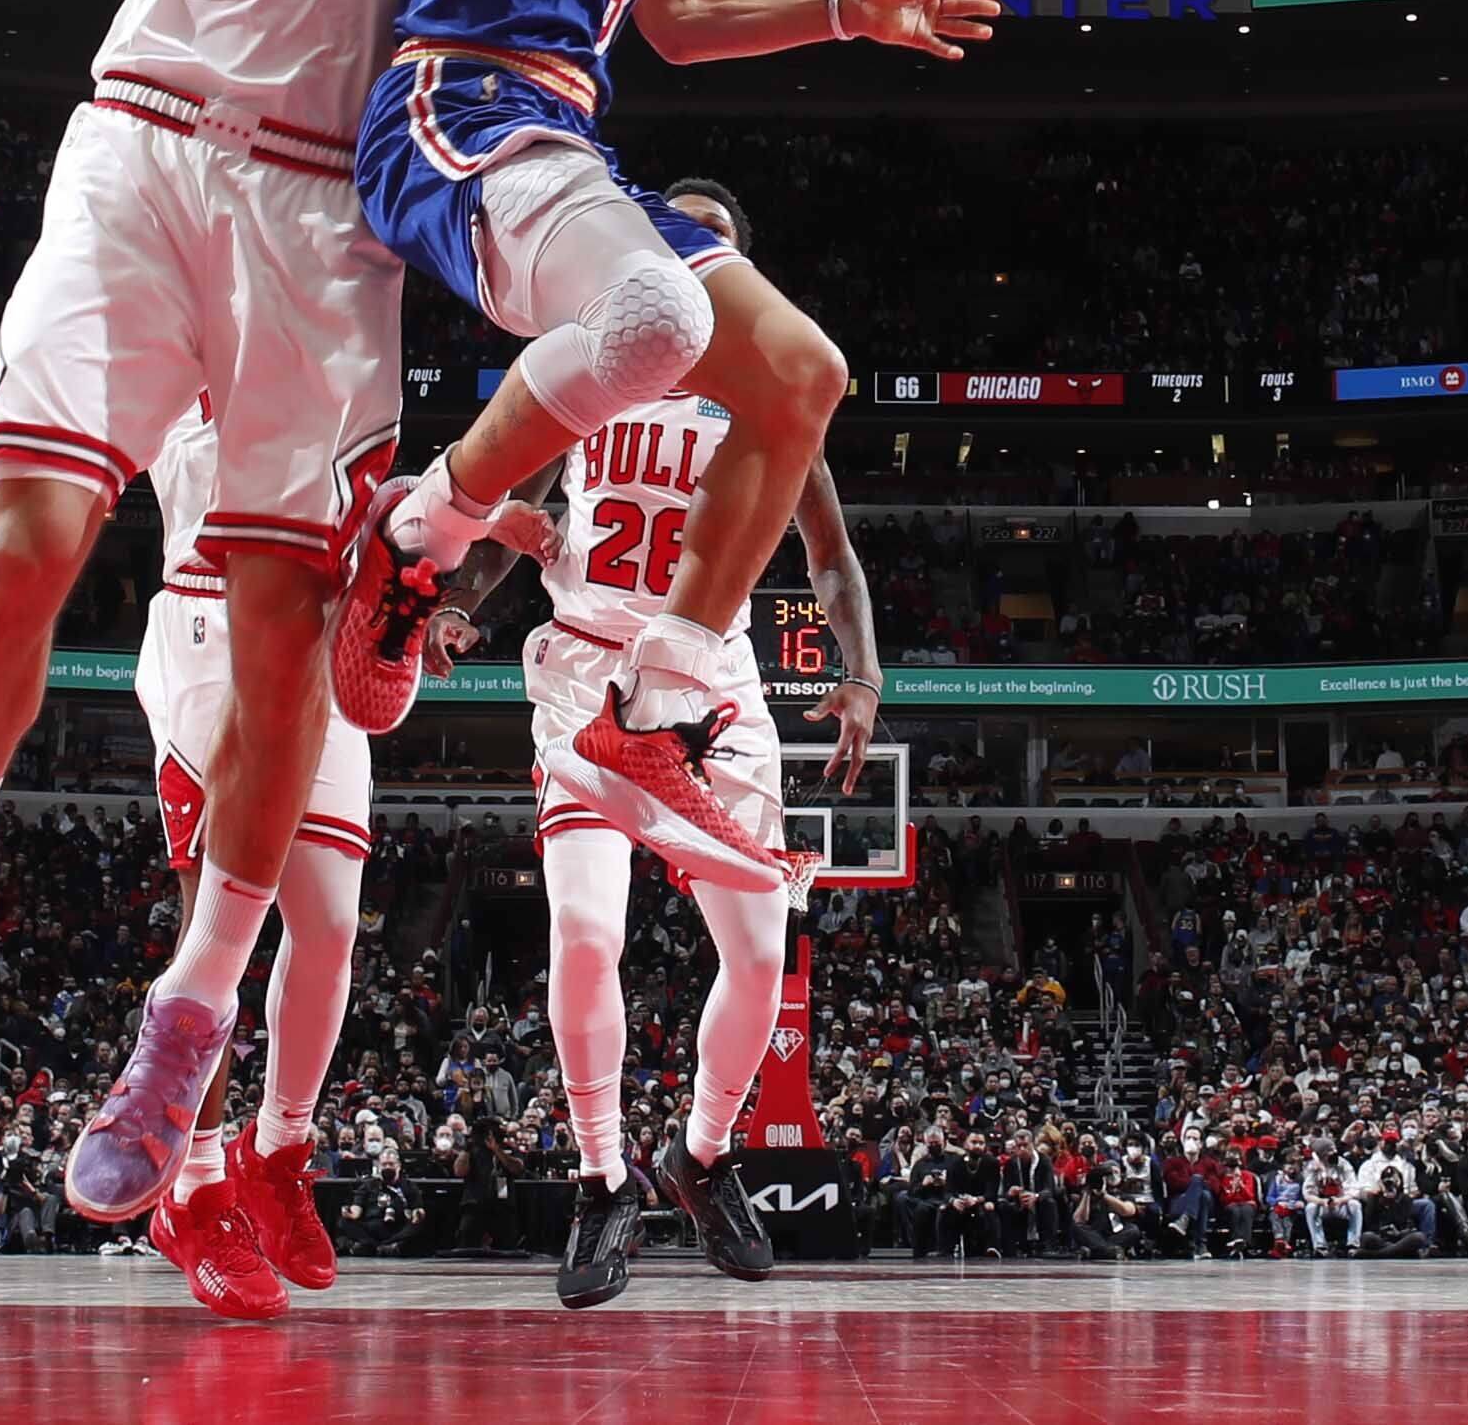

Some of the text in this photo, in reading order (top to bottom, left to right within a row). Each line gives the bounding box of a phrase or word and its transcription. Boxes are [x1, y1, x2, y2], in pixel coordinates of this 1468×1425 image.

[407, 369, 441, 382] FOULS
[1151, 375, 1202, 388] TIMEOUTS
[1260, 373, 1293, 386] FOULS
[1400, 376, 1434, 389] BMO
[421, 384, 428, 397] 0
[895, 377, 919, 398] 66
[966, 376, 1040, 399] CHICAGO
[1273, 387, 1282, 402] 3
[1173, 388, 1181, 403] 2
[783, 628, 821, 672] 16
[772, 683, 837, 694] TISSOT
[896, 680, 1095, 695] Excellence is just the beginning.
[766, 1124, 803, 1147] @NBA
